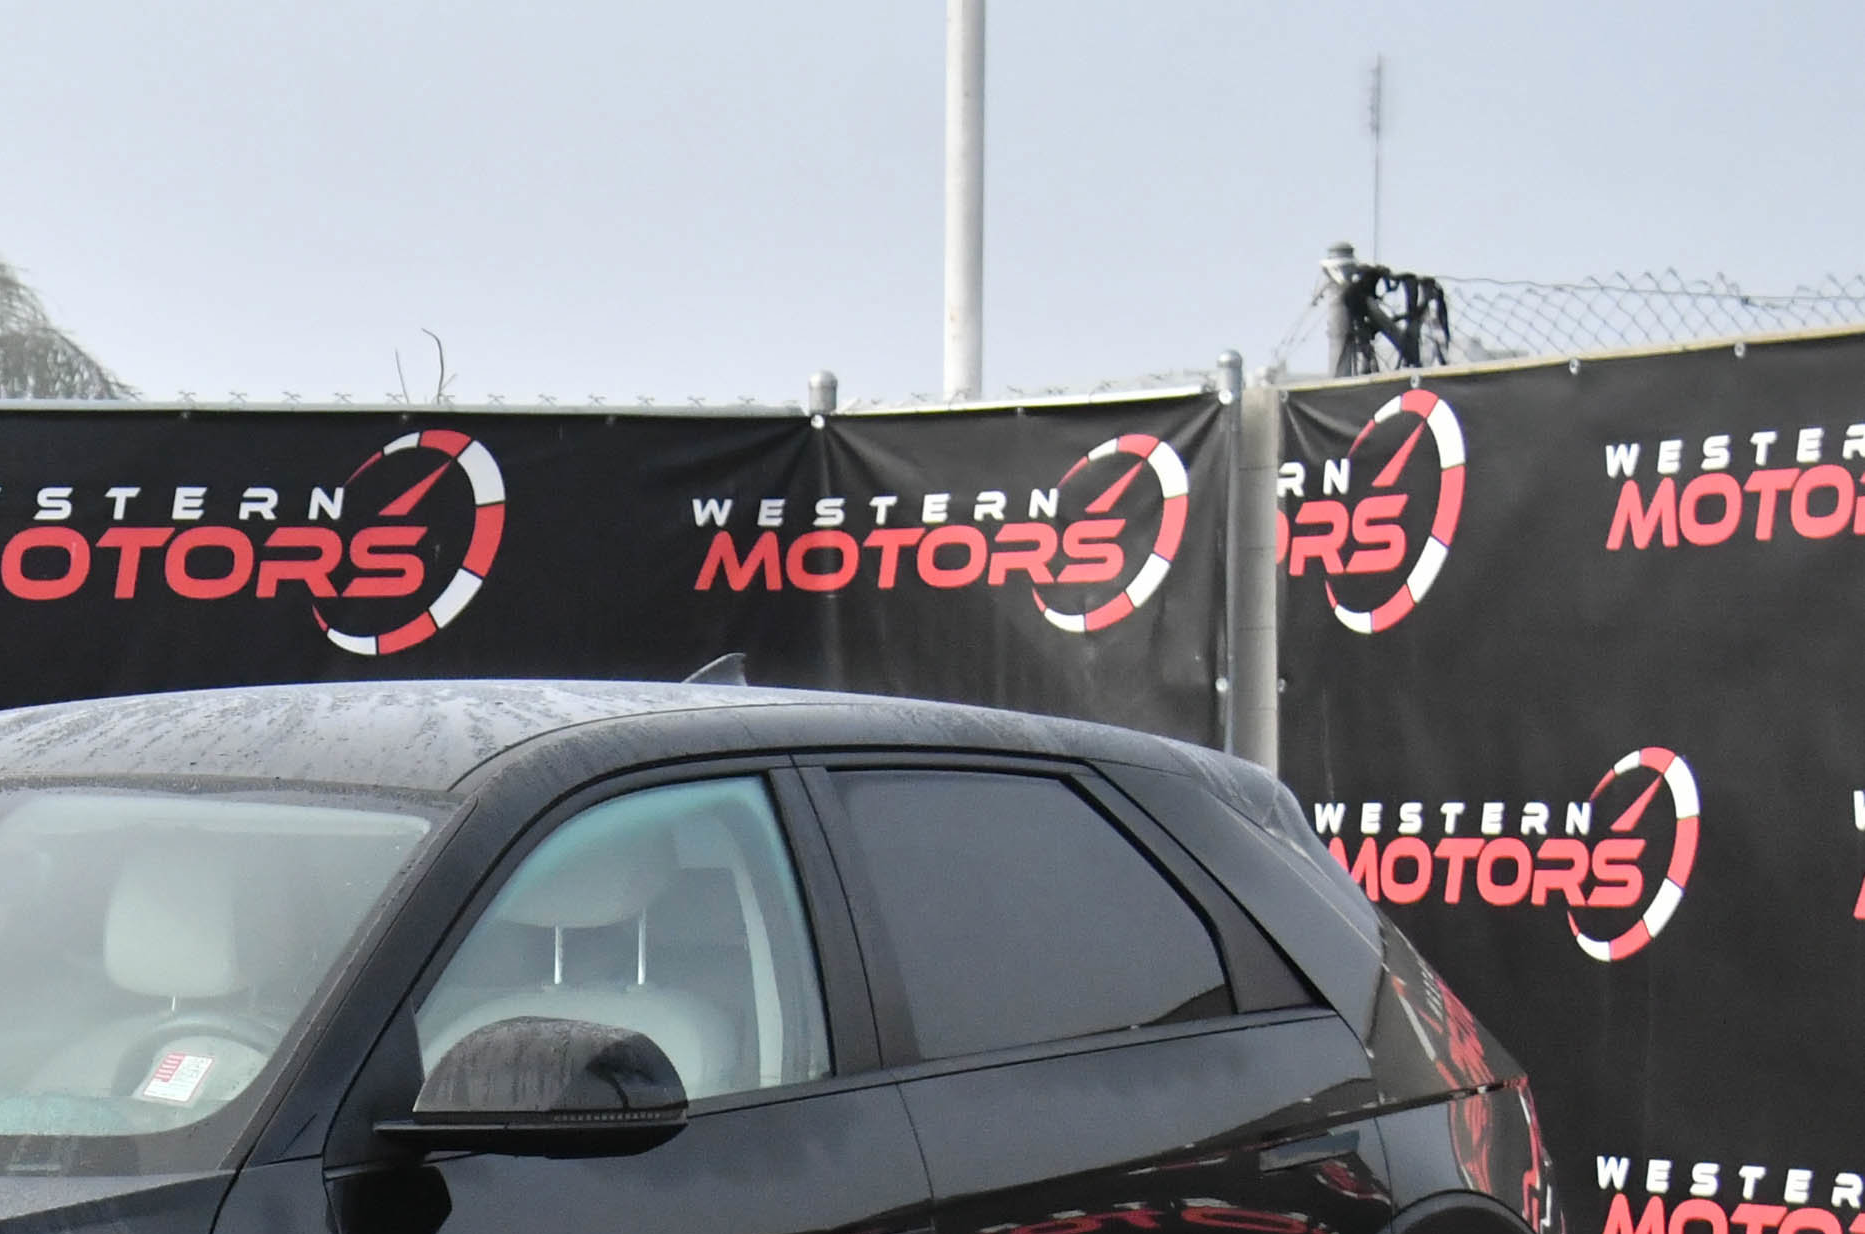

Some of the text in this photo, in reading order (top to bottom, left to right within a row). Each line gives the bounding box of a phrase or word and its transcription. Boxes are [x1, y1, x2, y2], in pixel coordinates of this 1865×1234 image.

[692, 488, 1059, 527] WESTERN
[1277, 494, 1409, 576] RS
[1607, 464, 1865, 550] MOTO
[695, 519, 1126, 592] MOTORS
[1315, 802, 1591, 835] WESTERN
[1329, 836, 1646, 908] MOTORS
